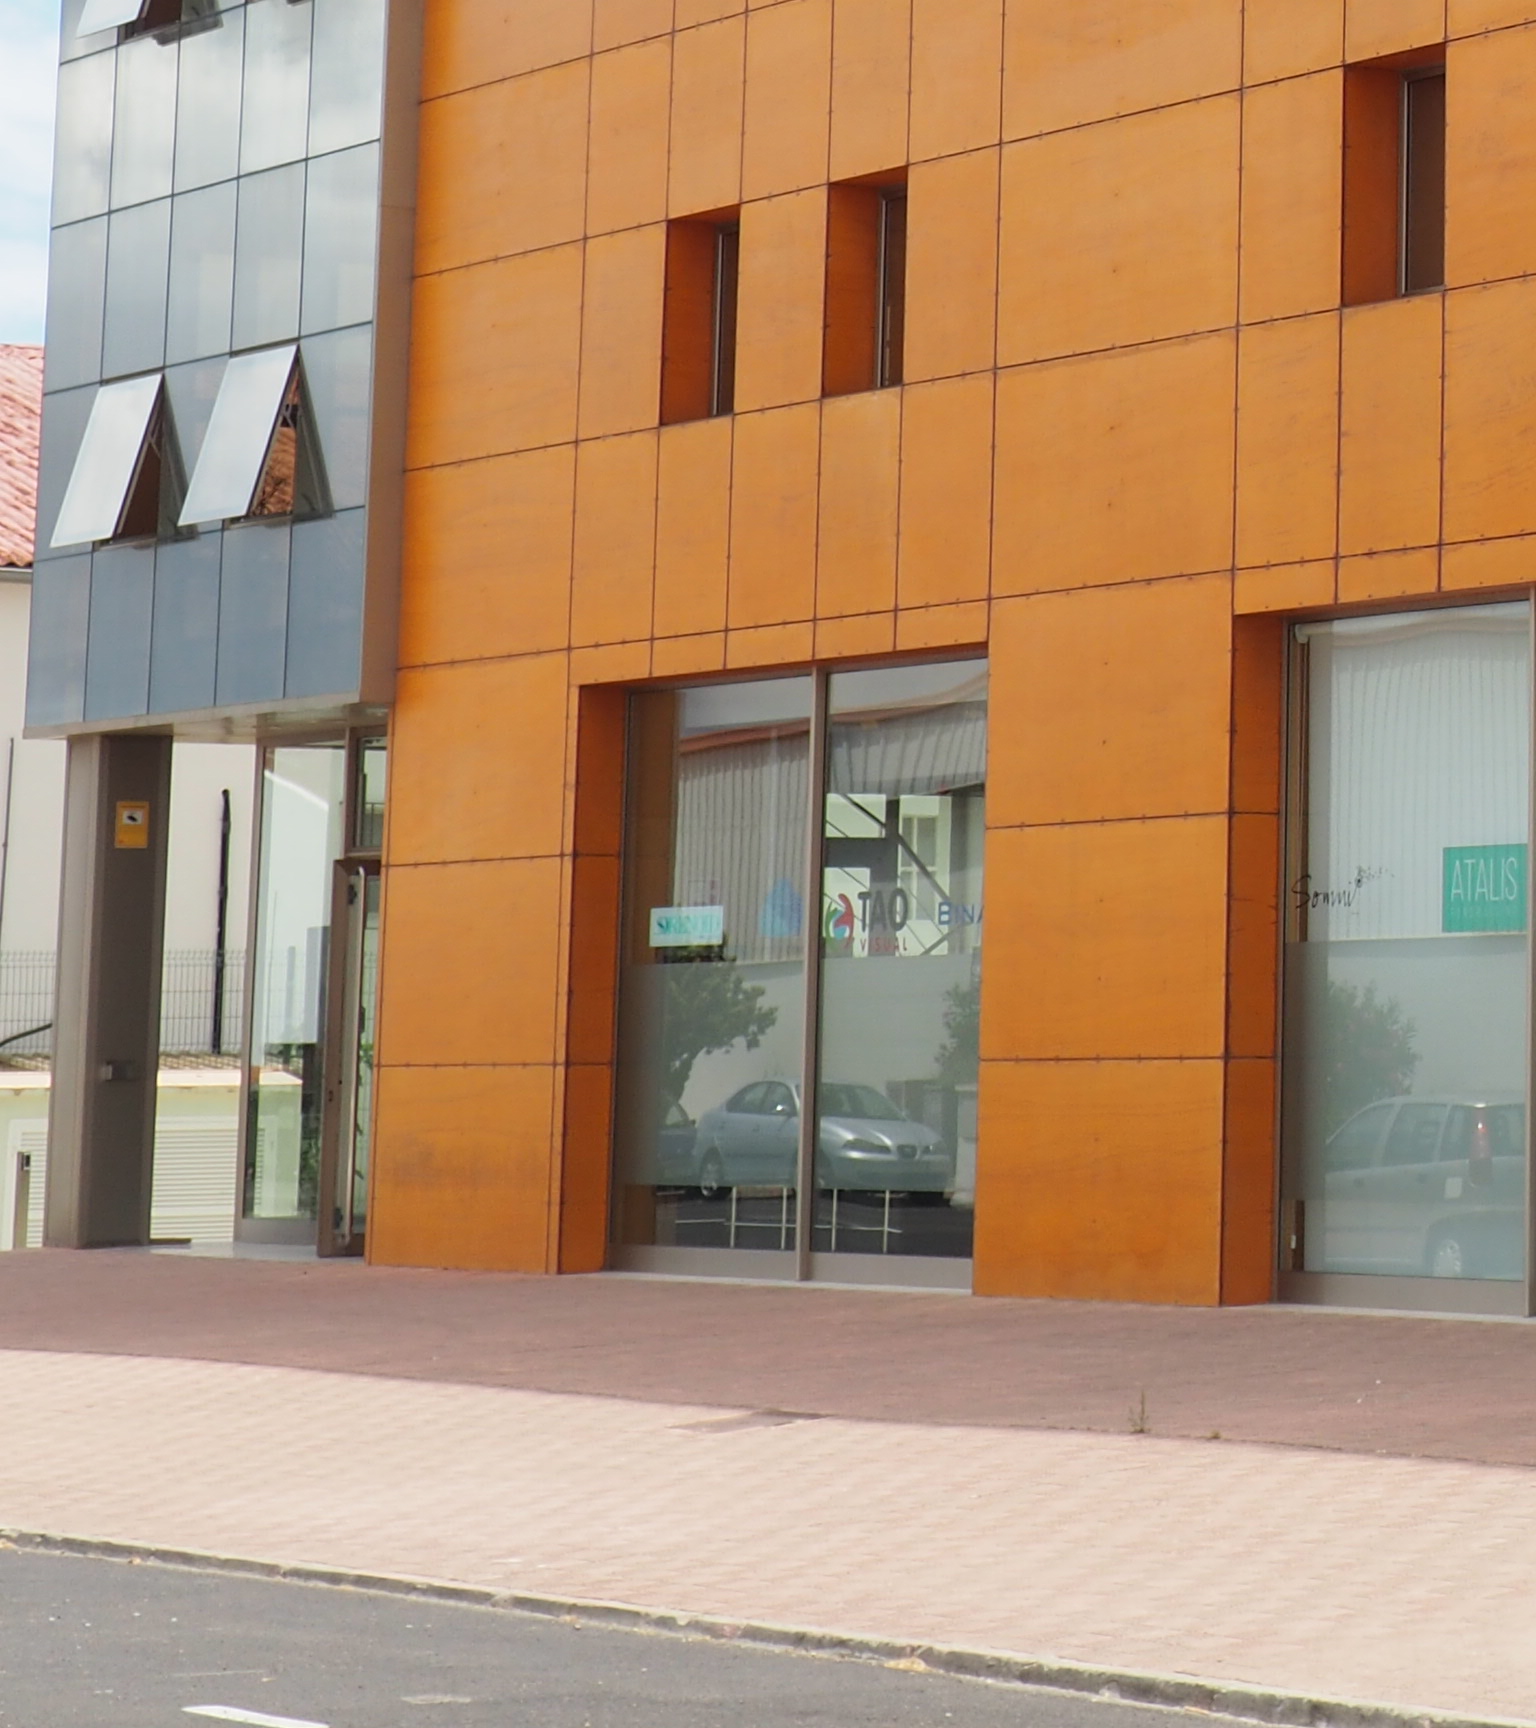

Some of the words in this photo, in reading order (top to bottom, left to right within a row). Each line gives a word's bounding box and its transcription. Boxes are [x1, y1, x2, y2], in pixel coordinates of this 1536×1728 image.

[1450, 856, 1518, 903] ATALIS
[857, 888, 908, 933] TAO
[860, 936, 908, 953] VISUAL
